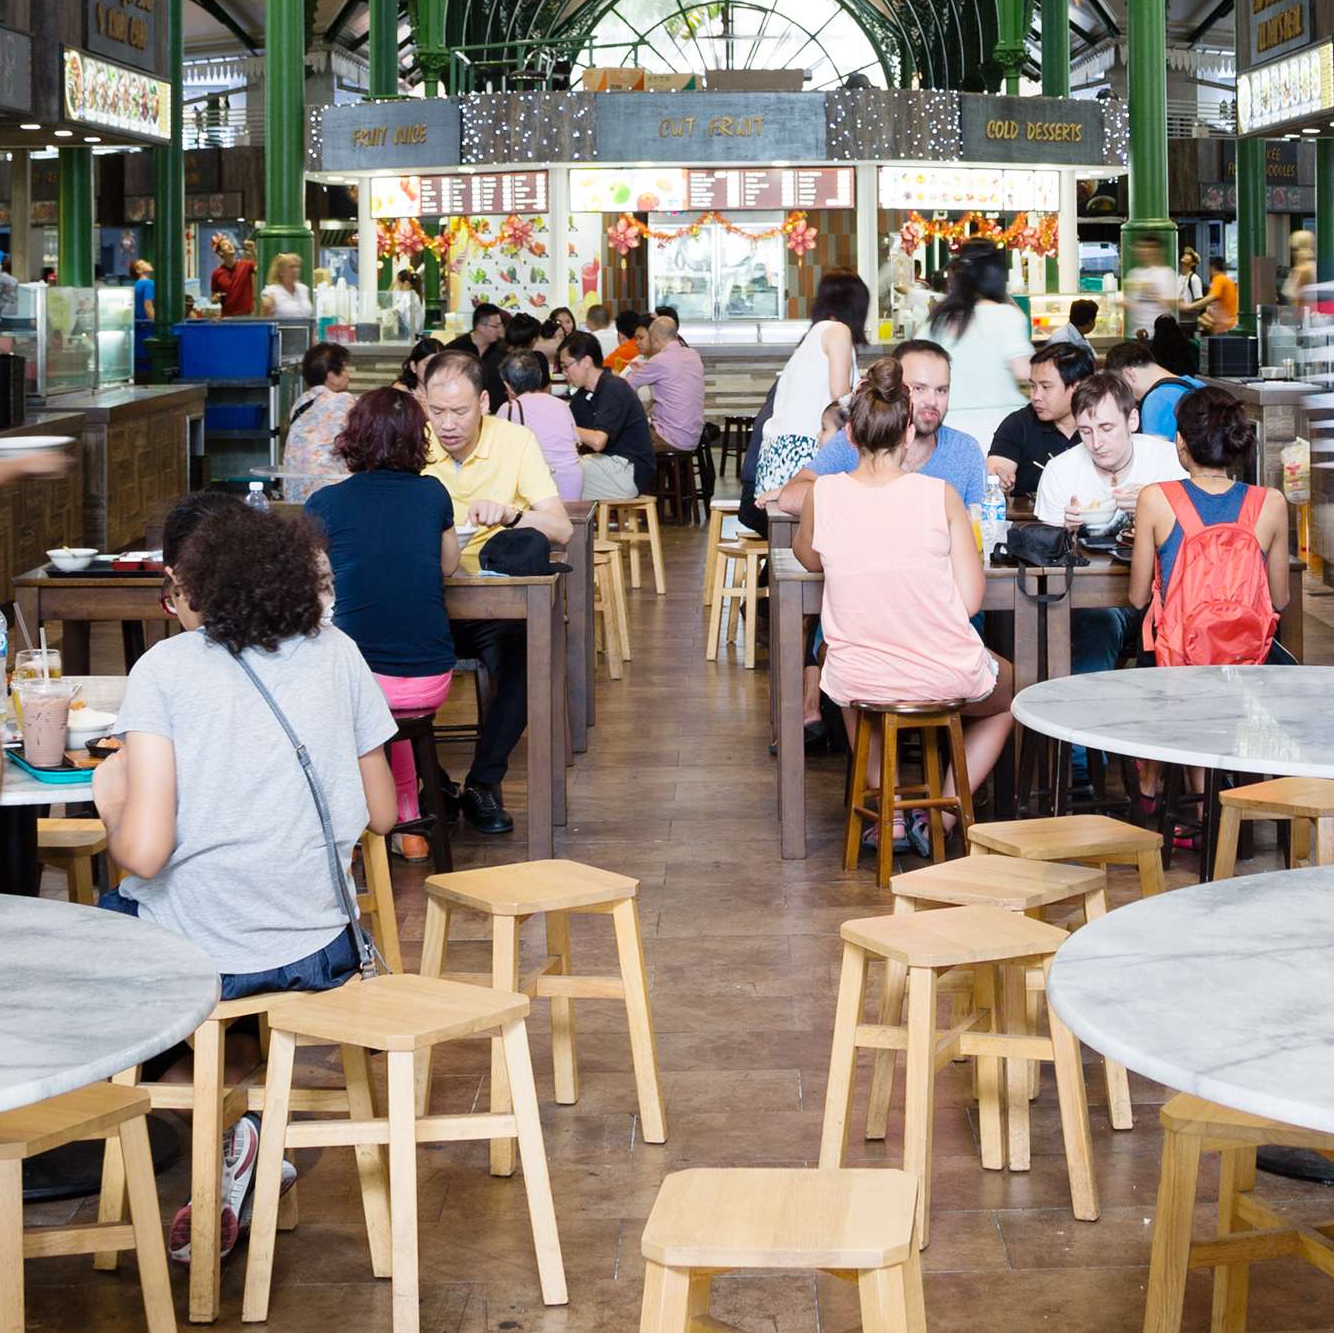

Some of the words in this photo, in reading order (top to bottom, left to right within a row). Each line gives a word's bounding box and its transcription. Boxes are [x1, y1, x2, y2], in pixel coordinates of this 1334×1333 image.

[353, 126, 387, 147] FRUIT
[394, 123, 427, 146] JUICE
[658, 116, 695, 138] CUT
[707, 115, 764, 138] FRUIT
[986, 119, 1019, 139] COLD
[1025, 121, 1083, 142] DESSERTS
